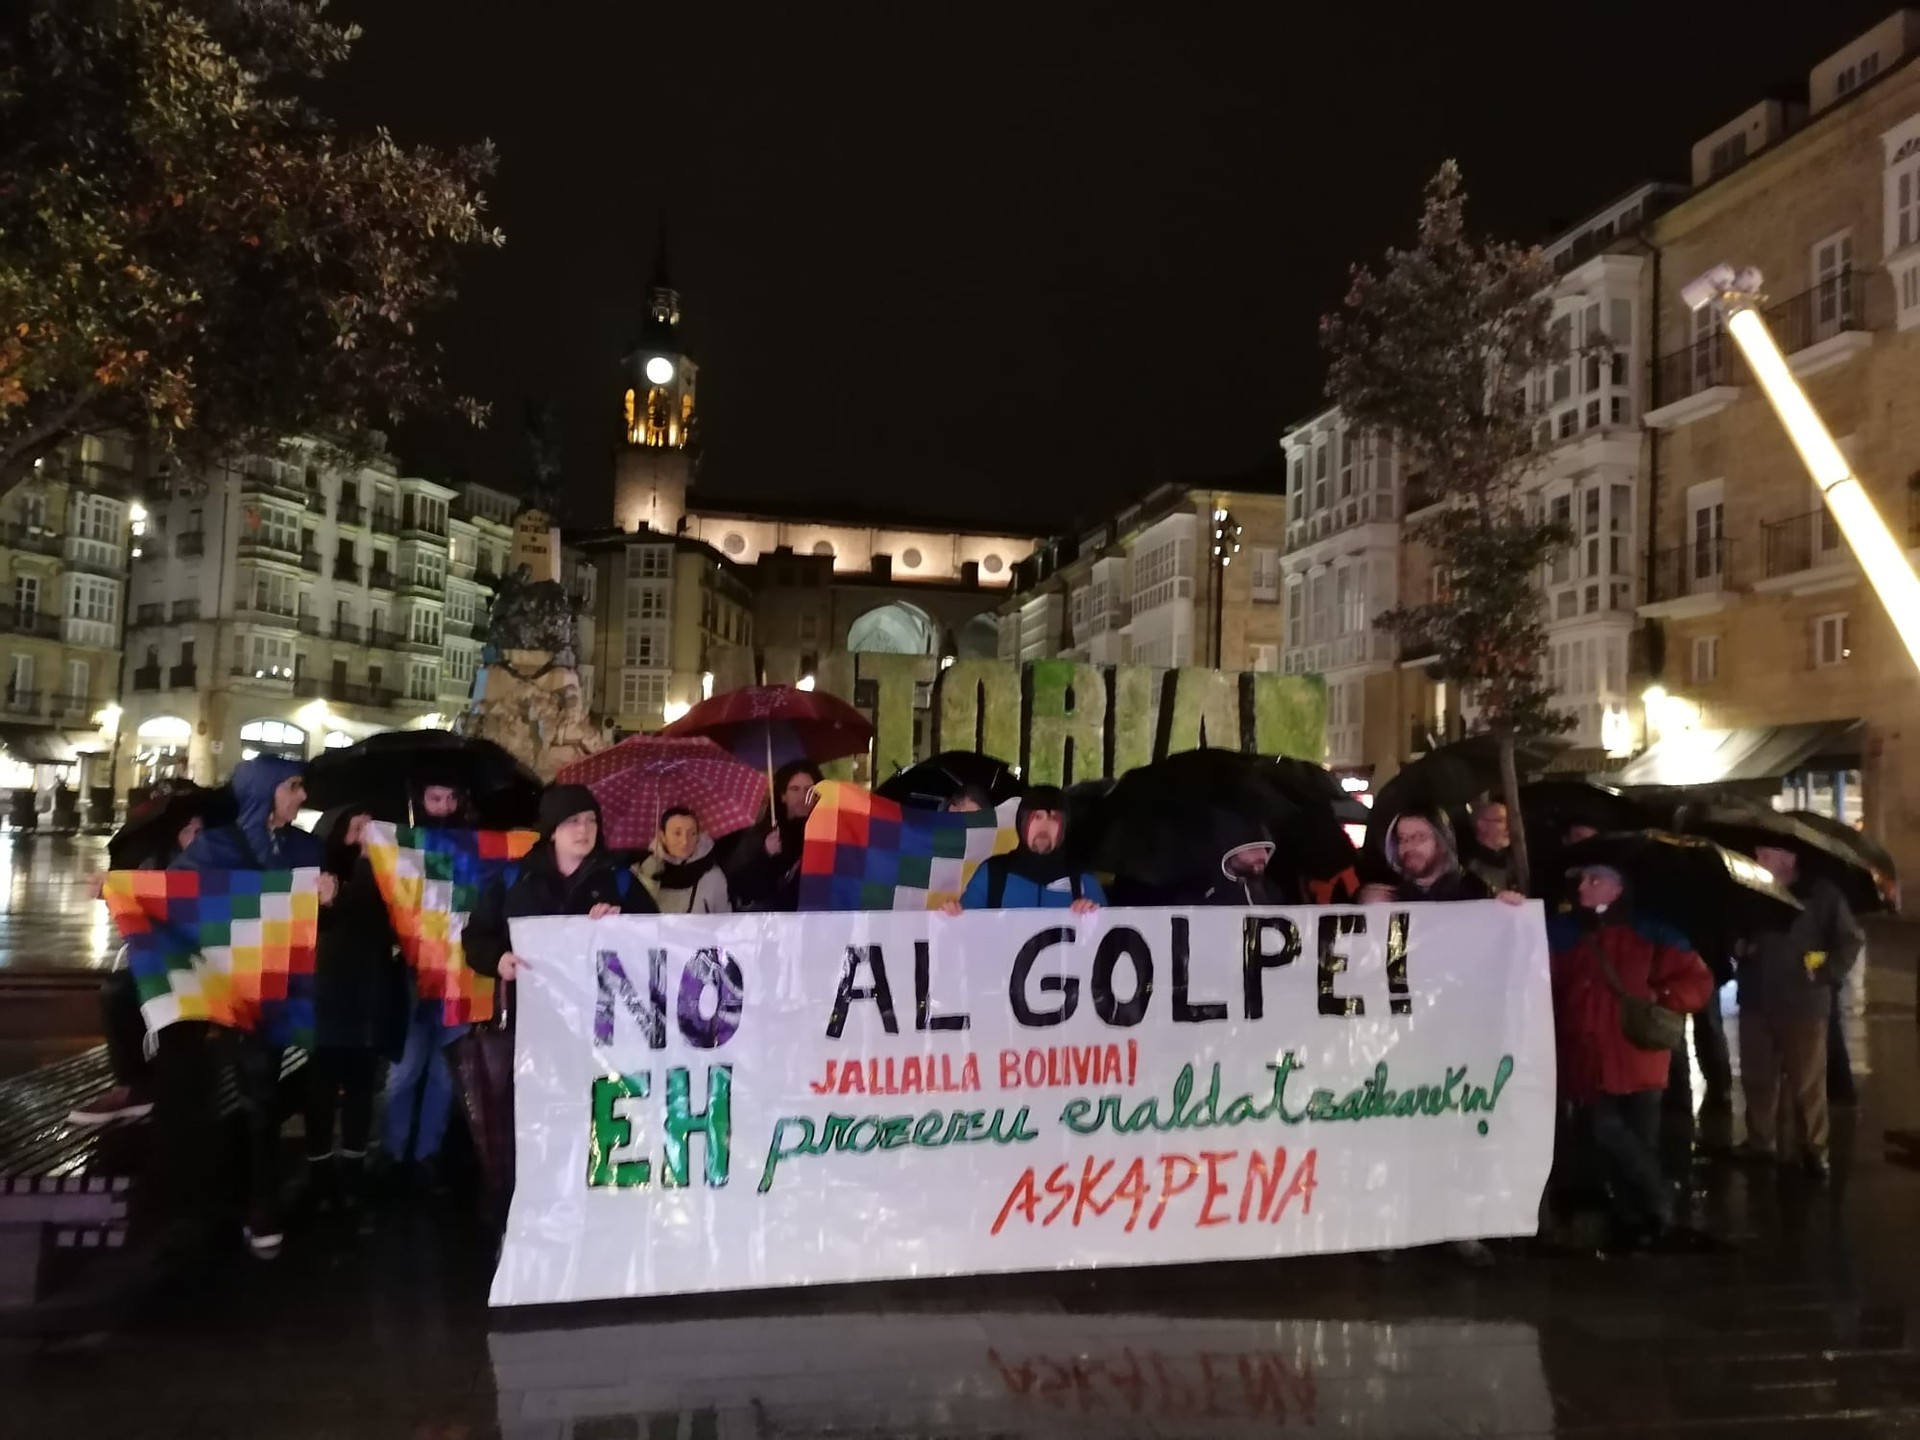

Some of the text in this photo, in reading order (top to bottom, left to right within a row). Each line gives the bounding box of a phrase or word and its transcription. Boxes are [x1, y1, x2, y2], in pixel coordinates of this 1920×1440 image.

[594, 912, 1413, 1050] NO AL GOLPE!
[809, 1038, 1139, 1096] JALLALLA BOLIVIA!
[587, 1063, 733, 1189] EH
[990, 1146, 1319, 1236] ASKAPENA
